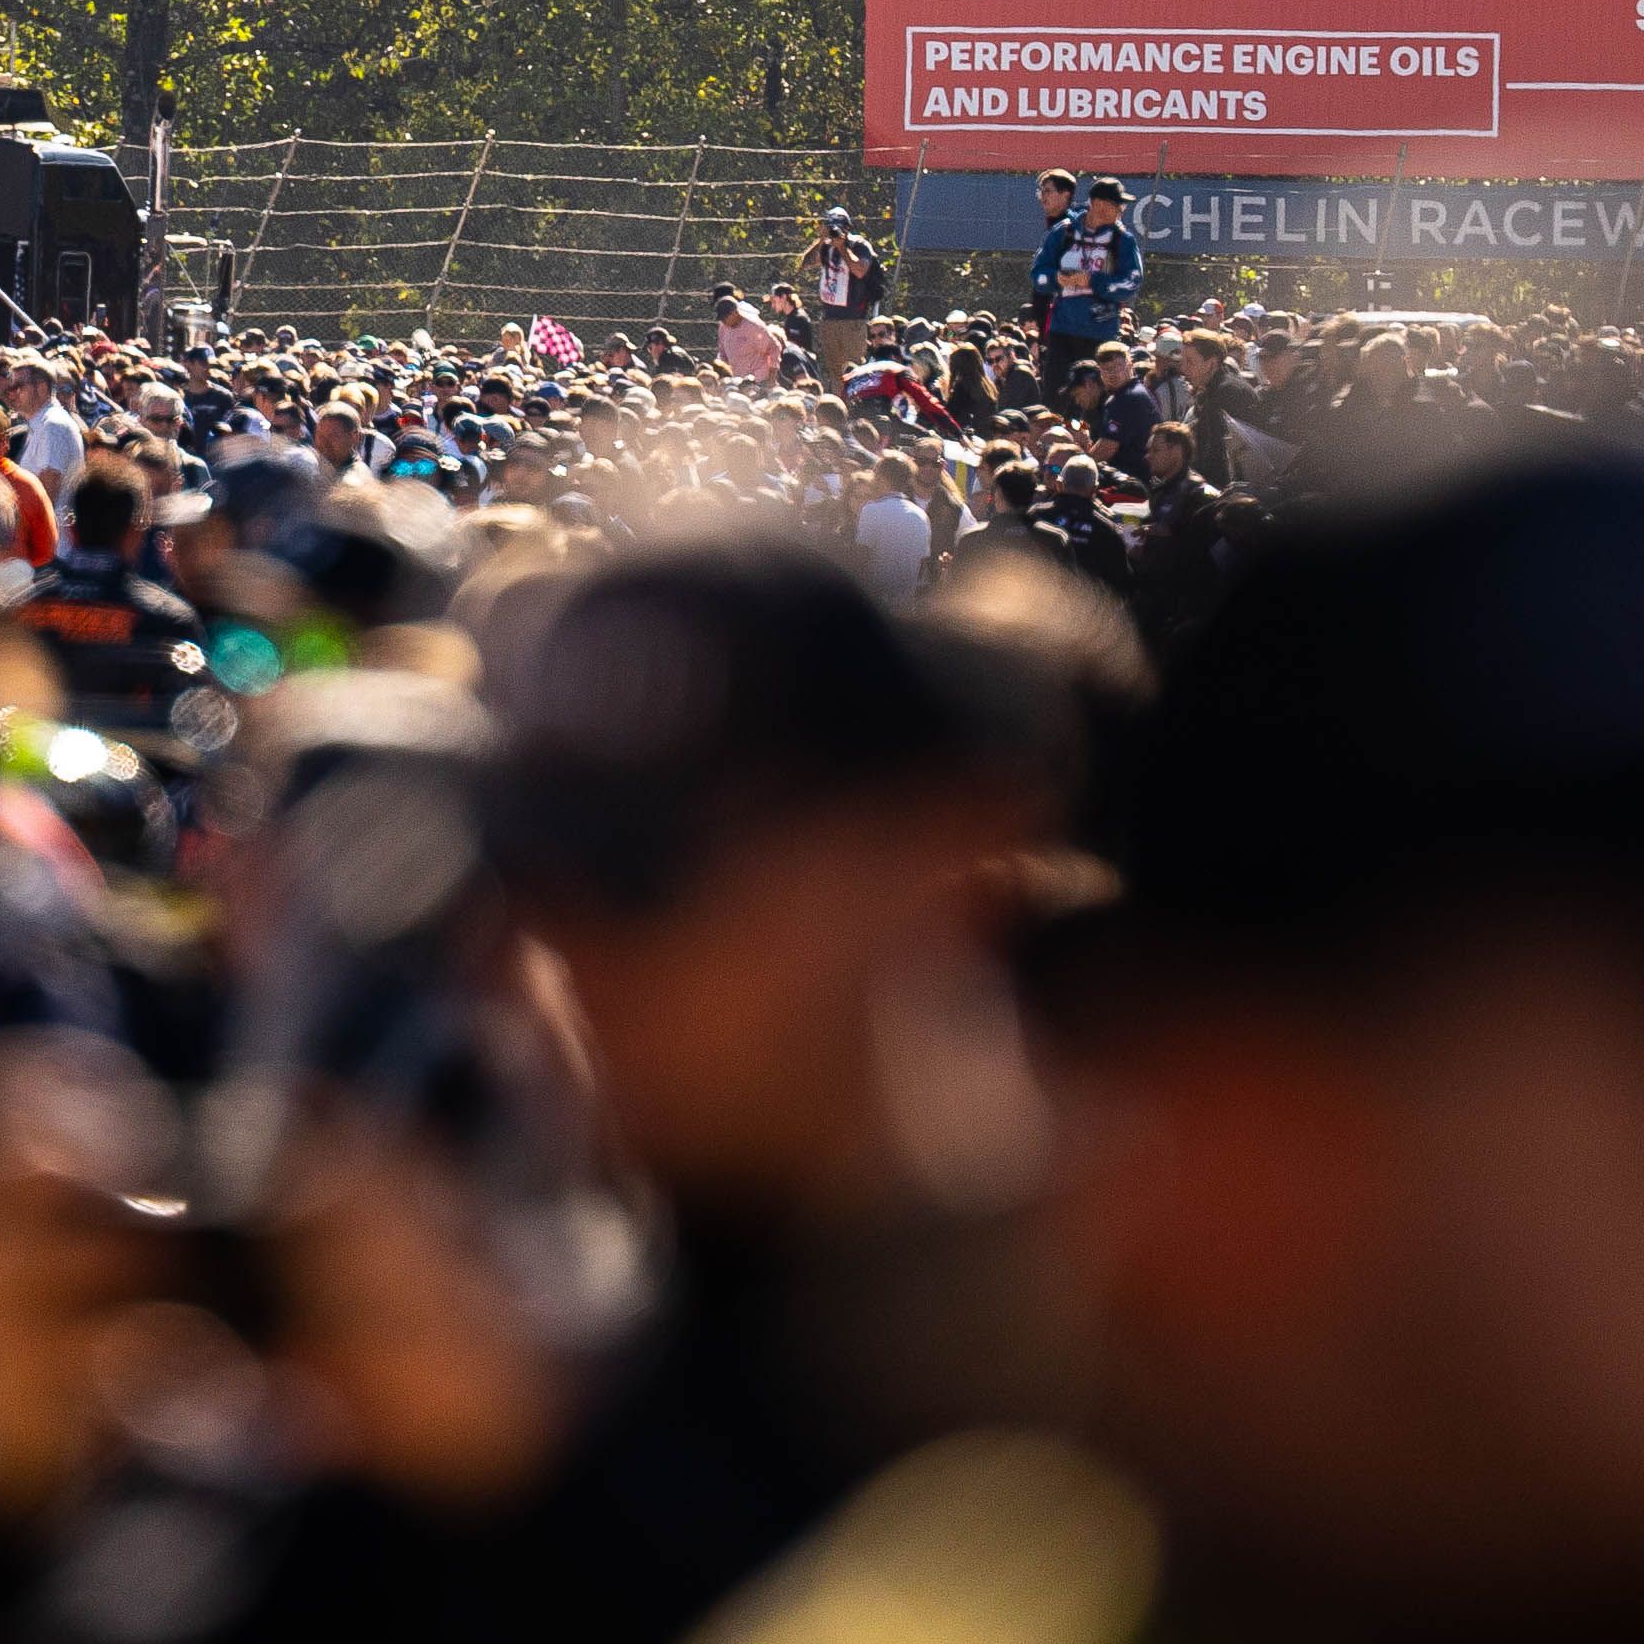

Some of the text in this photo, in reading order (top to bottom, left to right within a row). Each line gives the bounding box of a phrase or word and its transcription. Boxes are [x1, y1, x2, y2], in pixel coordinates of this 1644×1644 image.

[925, 42, 1480, 78] PERFORMANCE ENGINE OILS
[923, 88, 1267, 121] AND LUBRICANTS
[1134, 194, 1378, 247] CHELIN
